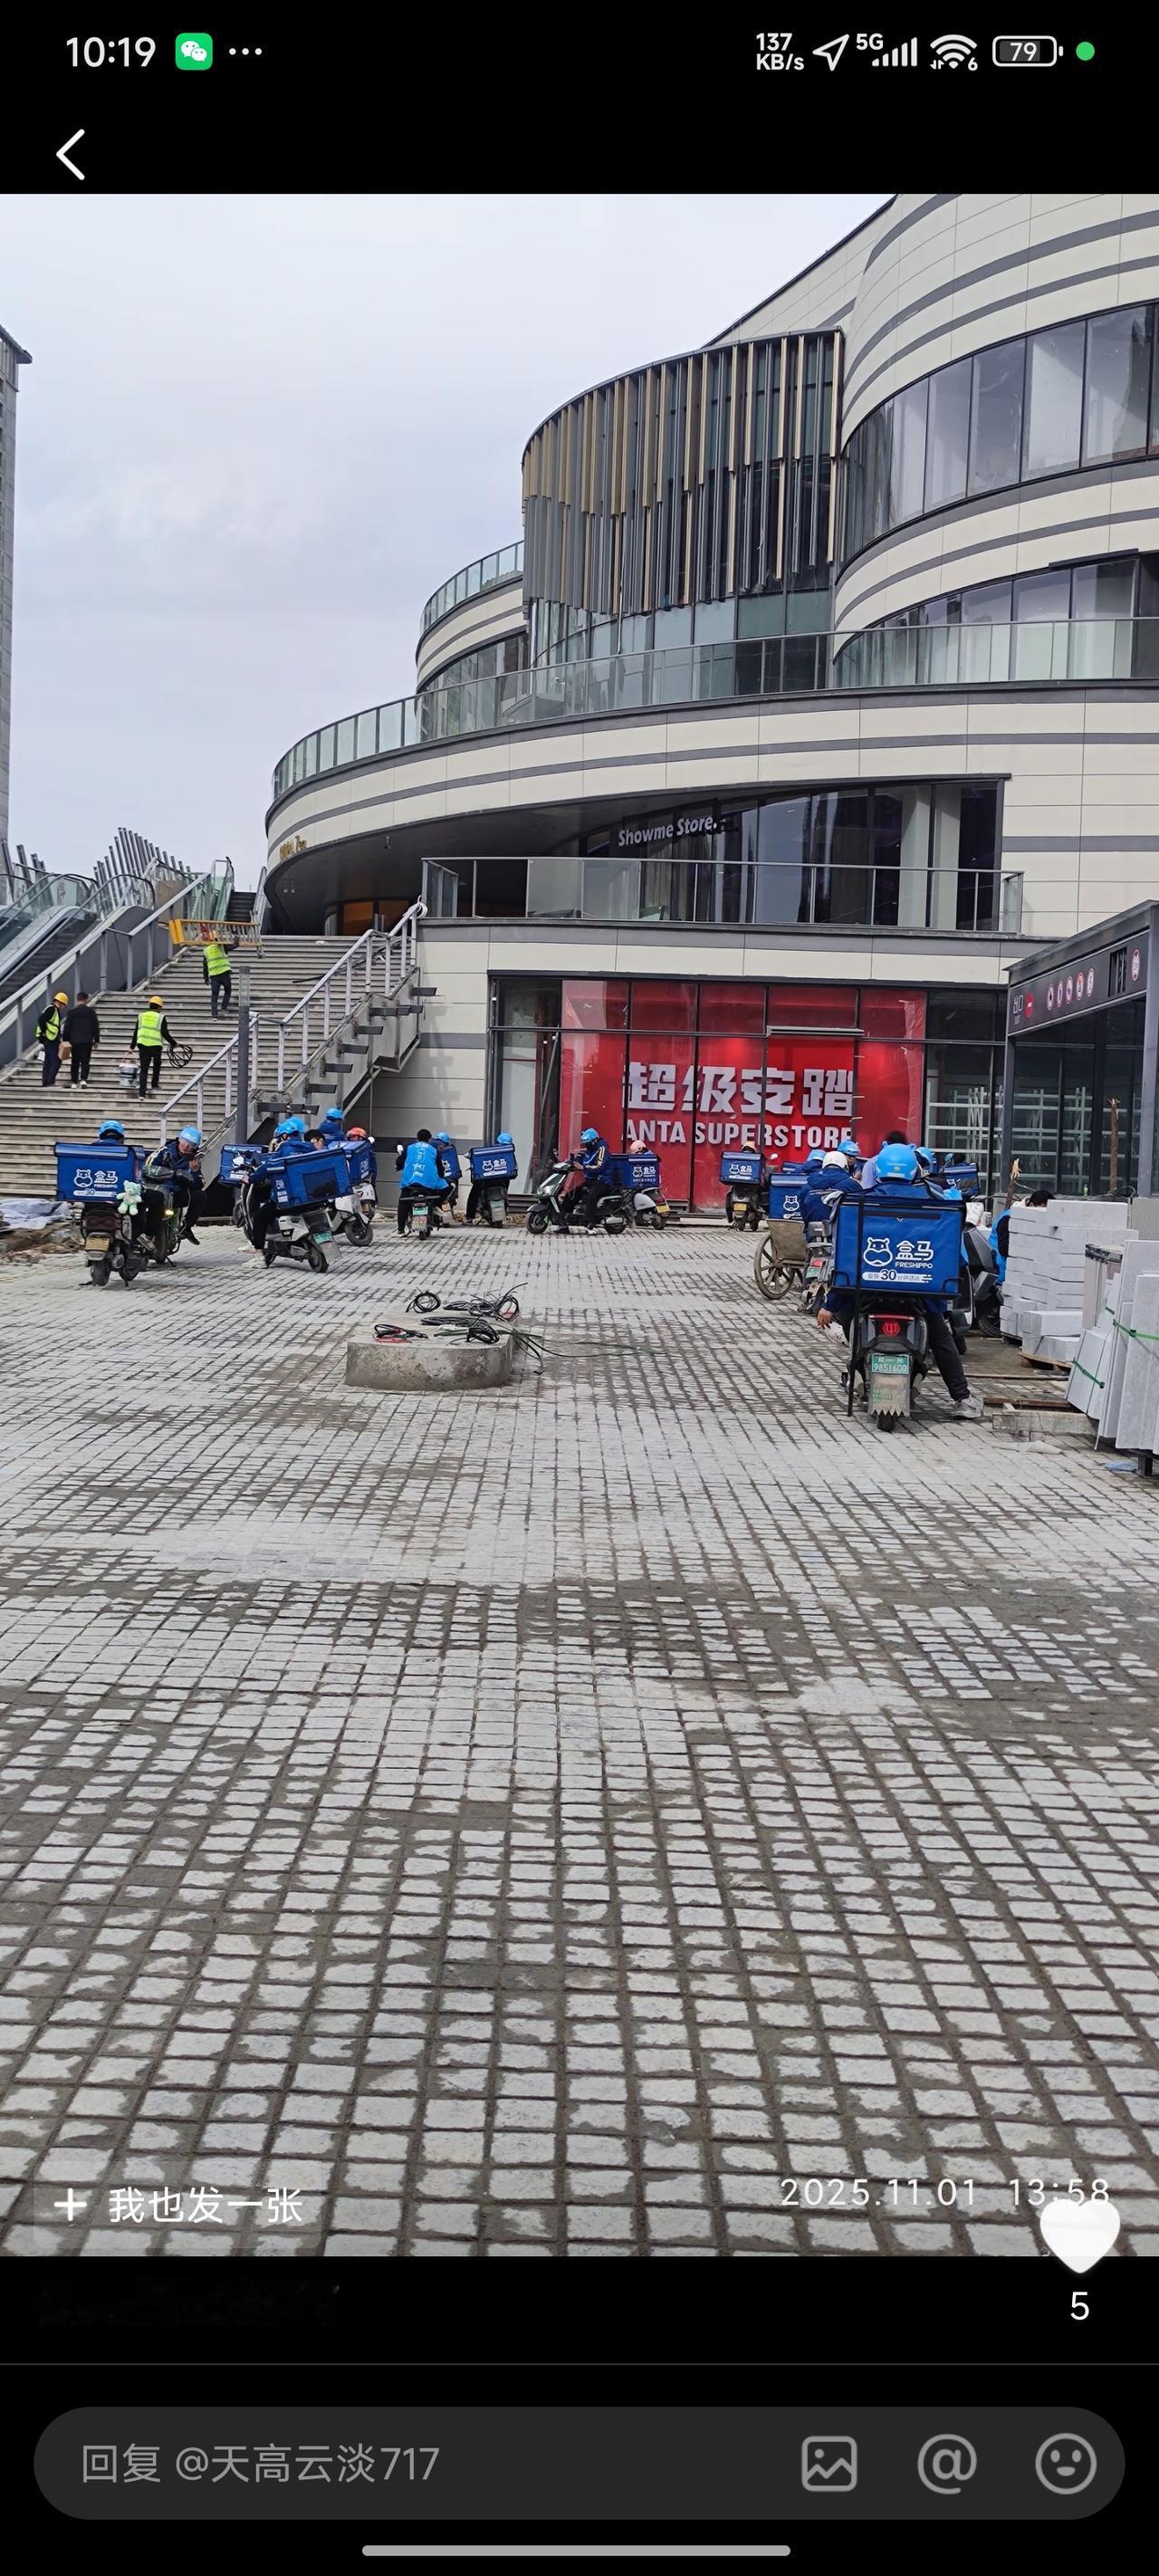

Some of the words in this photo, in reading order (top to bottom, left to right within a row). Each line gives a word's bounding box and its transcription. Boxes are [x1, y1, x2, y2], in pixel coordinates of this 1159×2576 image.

[618, 823, 674, 847] Showme
[622, 1062, 853, 1116] 超级安踏
[621, 1119, 686, 1143] ANTA
[94, 1170, 118, 1183] 盒马
[896, 1240, 934, 1261] 盒马
